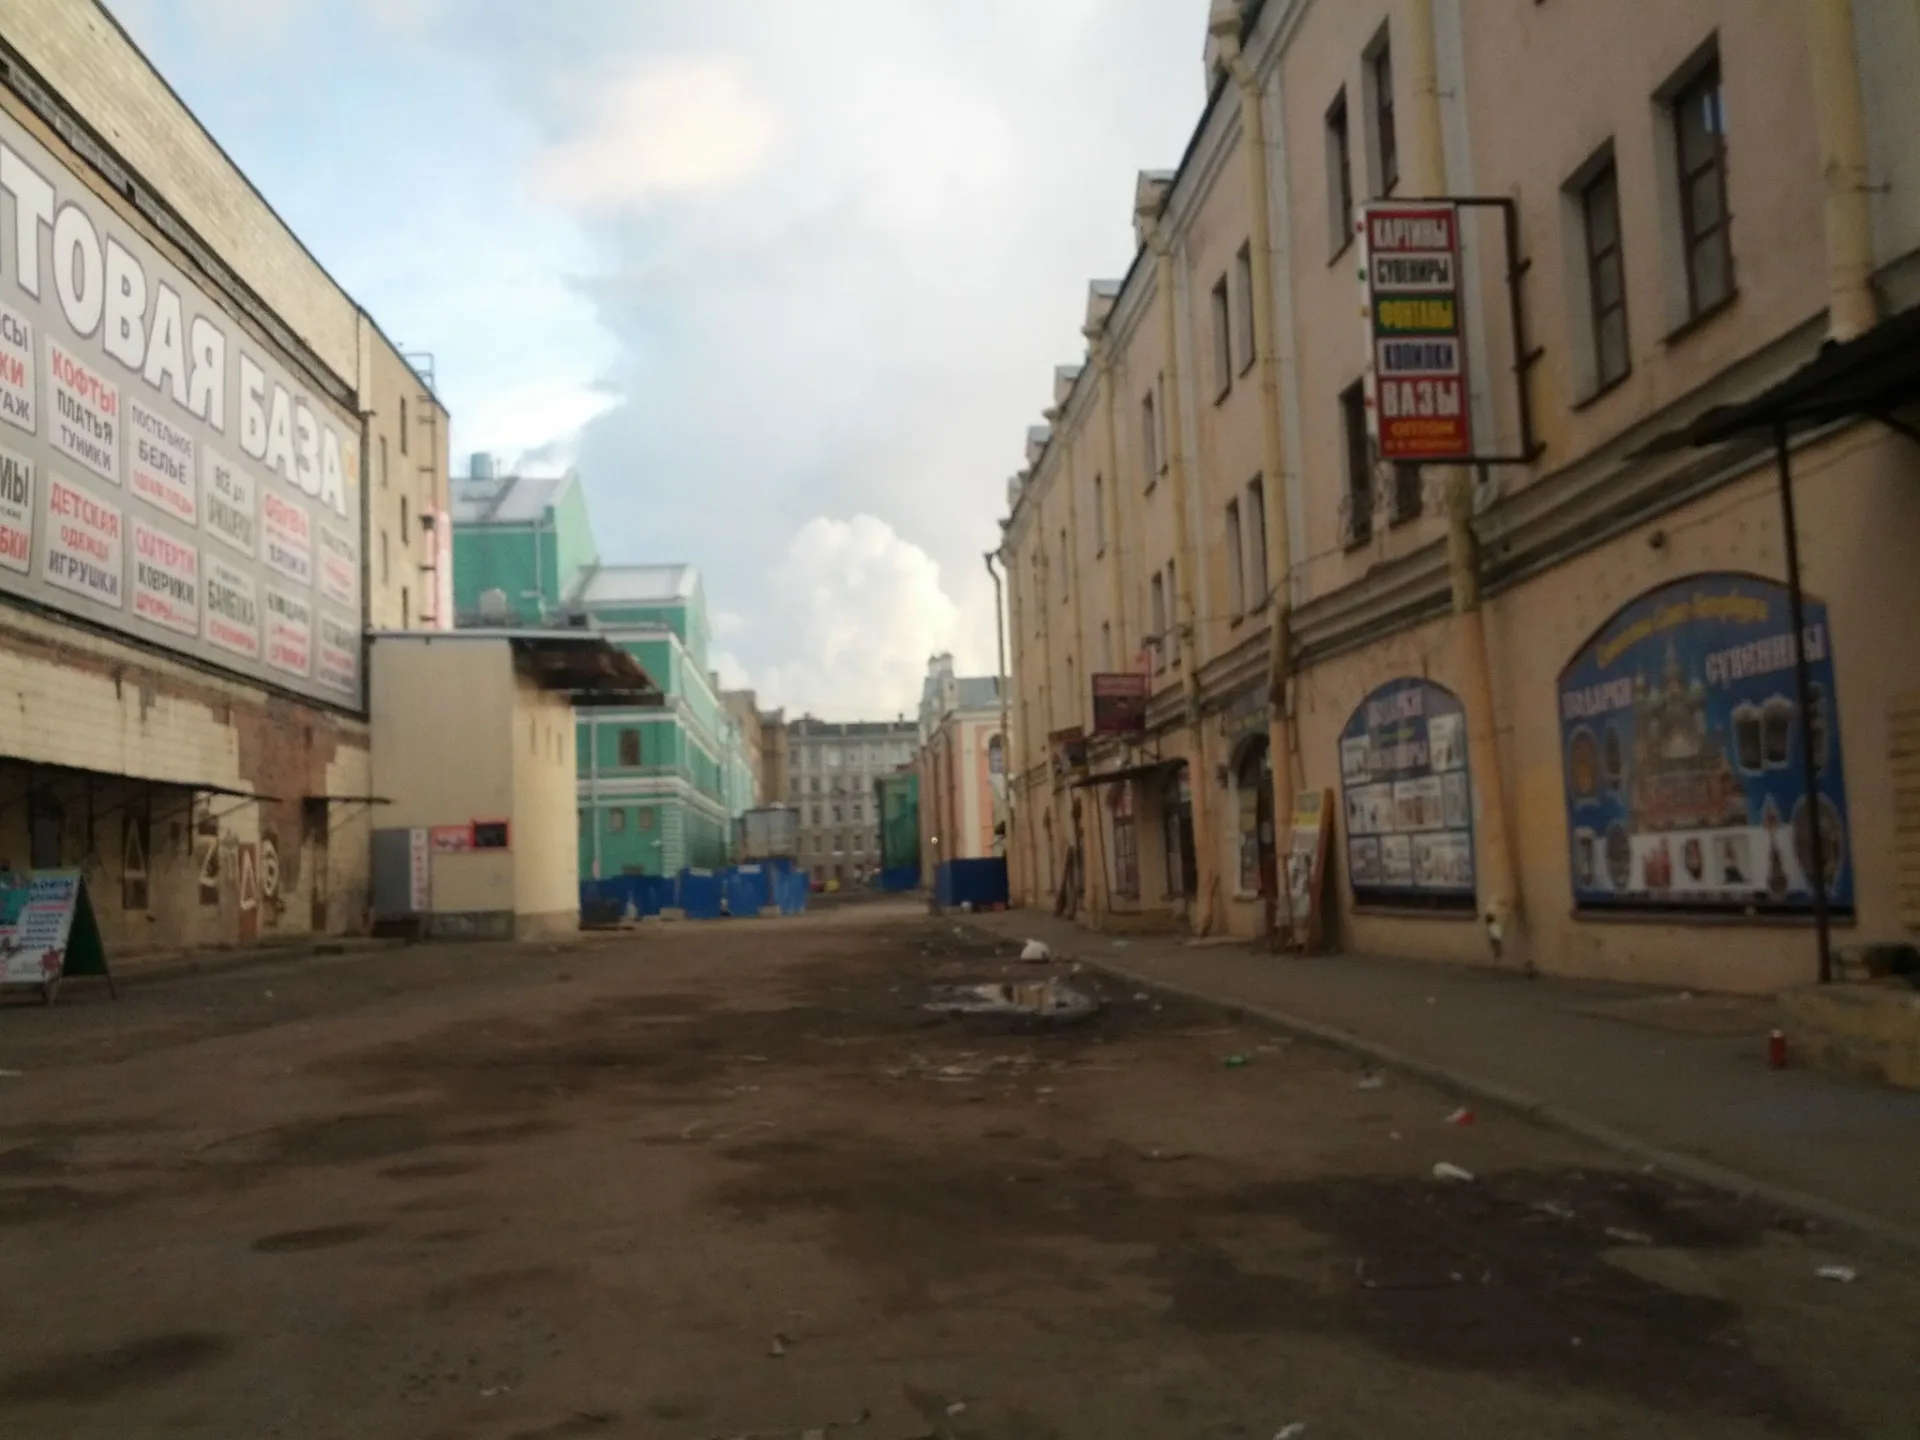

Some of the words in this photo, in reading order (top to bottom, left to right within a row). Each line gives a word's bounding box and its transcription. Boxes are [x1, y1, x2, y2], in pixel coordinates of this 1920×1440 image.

[1373, 217, 1448, 249] КАРТИНЫ
[1378, 258, 1449, 284] СУВЕНИРЫ
[52, 346, 116, 416] КОФТЫ
[1382, 381, 1460, 418] ВАЗЫ
[57, 388, 114, 445] ПЛАТЬЯ
[132, 405, 192, 459] ПОСТЕЛЬНОЕ
[240, 352, 348, 520] БАЗА
[61, 424, 111, 471] ТУНИКИ
[138, 438, 187, 486] БЕЛЬЕ
[50, 482, 119, 538] ДЕТСКАЯ
[48, 550, 118, 596] ИГРУШКИ
[136, 526, 195, 574] СКАТЕРТИ
[138, 561, 195, 605] КОВРИКИ
